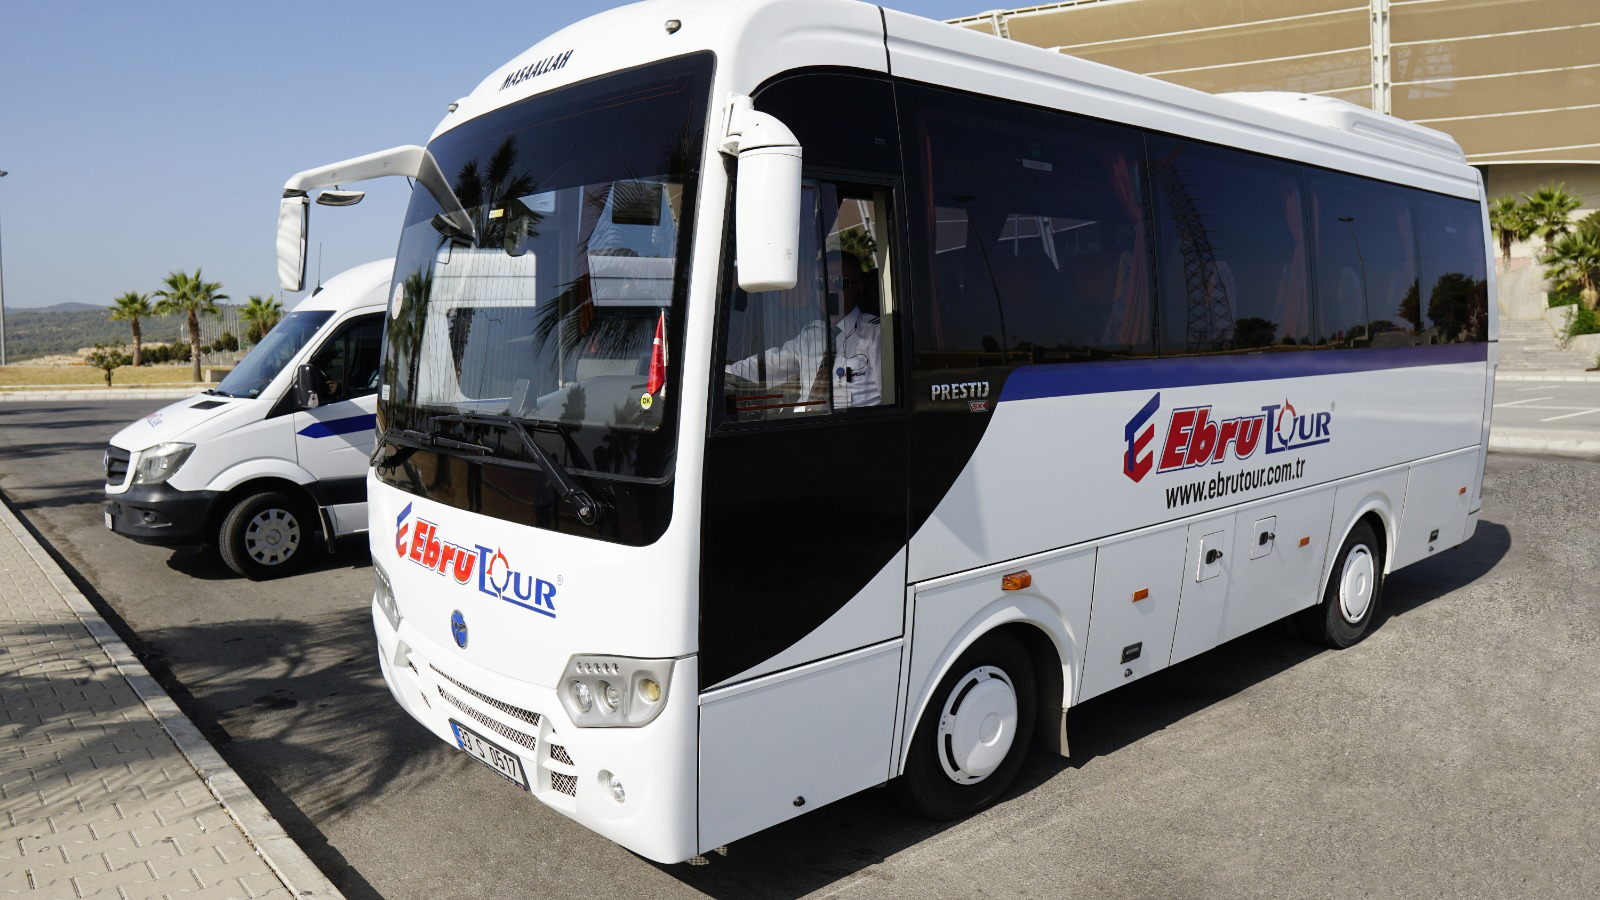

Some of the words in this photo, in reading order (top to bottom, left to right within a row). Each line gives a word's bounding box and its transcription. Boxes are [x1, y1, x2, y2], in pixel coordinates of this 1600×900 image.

[931, 382, 990, 401] PRESTIJ
[1166, 458, 1306, 509] www.ebrutour.com.tr
[475, 738, 486, 759] S
[489, 746, 517, 777] 0517
